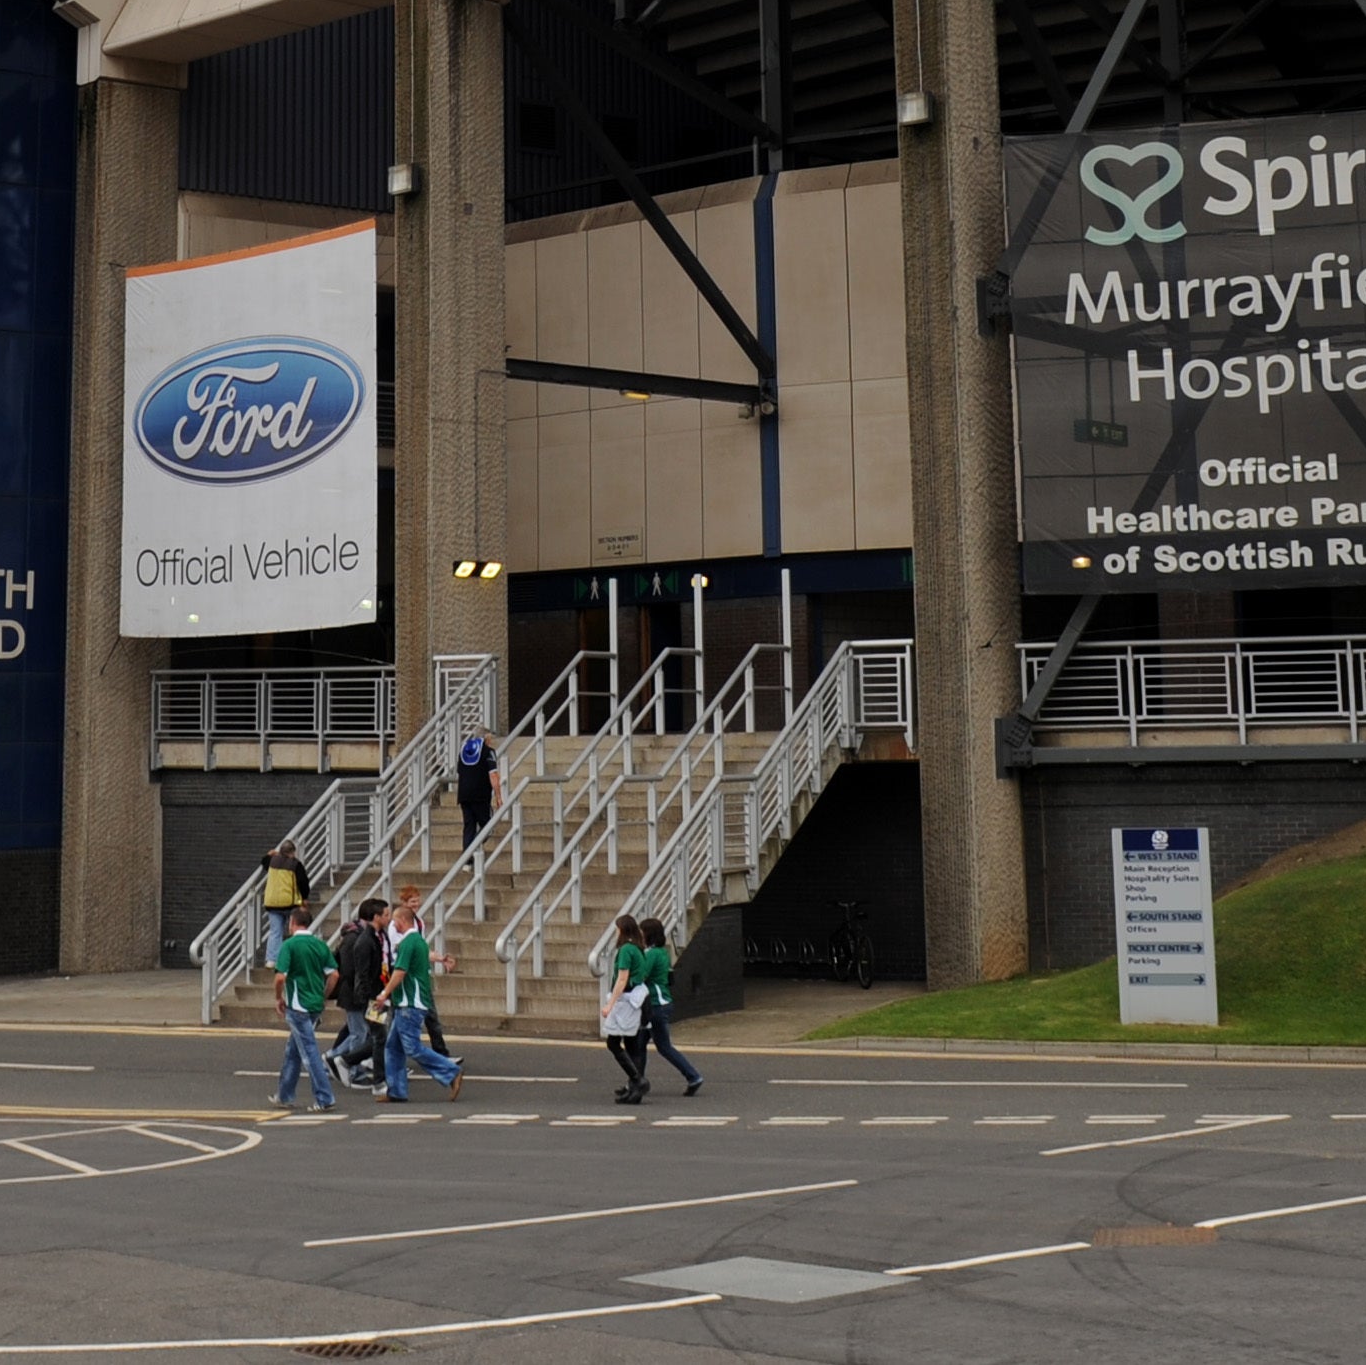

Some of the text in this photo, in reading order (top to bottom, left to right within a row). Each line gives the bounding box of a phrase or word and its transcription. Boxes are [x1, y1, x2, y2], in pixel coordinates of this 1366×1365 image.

[172, 361, 318, 460] Ford
[1199, 453, 1339, 487] Official
[1087, 504, 1299, 534] Healthcare
[136, 532, 360, 587] Official Vehicle
[1103, 547, 1141, 574] of
[1154, 541, 1313, 574] Scottish
[1148, 864, 1190, 873] Reception
[1124, 875, 1170, 884] Hospitality
[1125, 885, 1147, 893] Shop
[1125, 895, 1158, 904] Parking
[1139, 913, 1202, 921] SOUTH STAND
[1128, 957, 1161, 966] Parking
